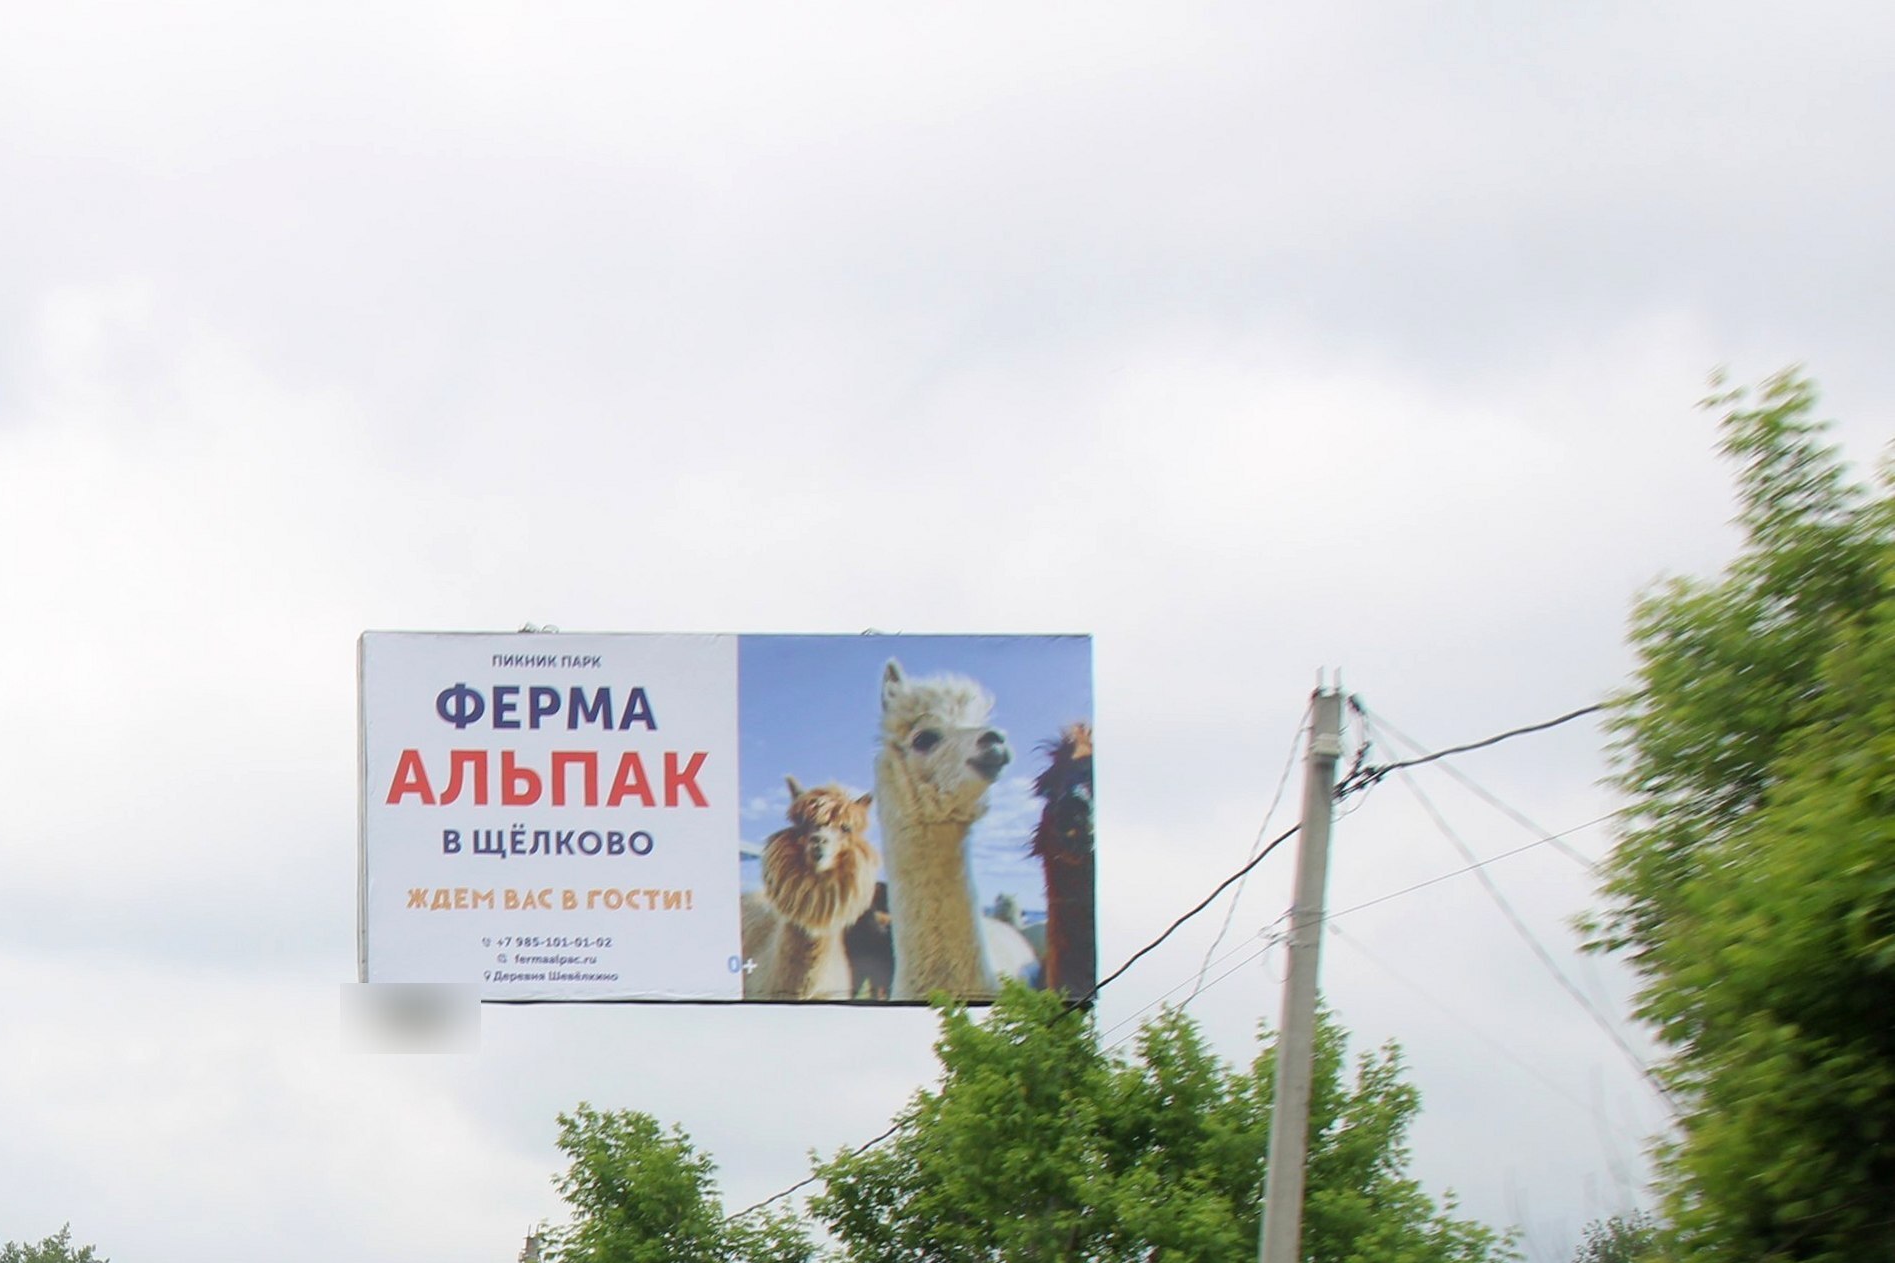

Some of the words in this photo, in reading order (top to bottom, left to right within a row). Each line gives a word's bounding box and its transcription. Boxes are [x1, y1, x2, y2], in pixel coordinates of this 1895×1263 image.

[492, 654, 558, 668] ПИКНИК
[561, 655, 602, 668] ПАРК
[436, 682, 658, 731] ФЕРМА
[385, 748, 710, 808] АЛЬПАК
[442, 830, 462, 854] В
[473, 823, 654, 859] ЩЁЛКОВО
[406, 888, 495, 911] ЖДЕМ
[504, 888, 553, 911] ВАС
[562, 889, 578, 911] В
[587, 888, 693, 911] ГОСТИ!
[496, 937, 513, 948] +7
[516, 936, 613, 948] 985-101-01-02
[493, 970, 546, 983] Деревня
